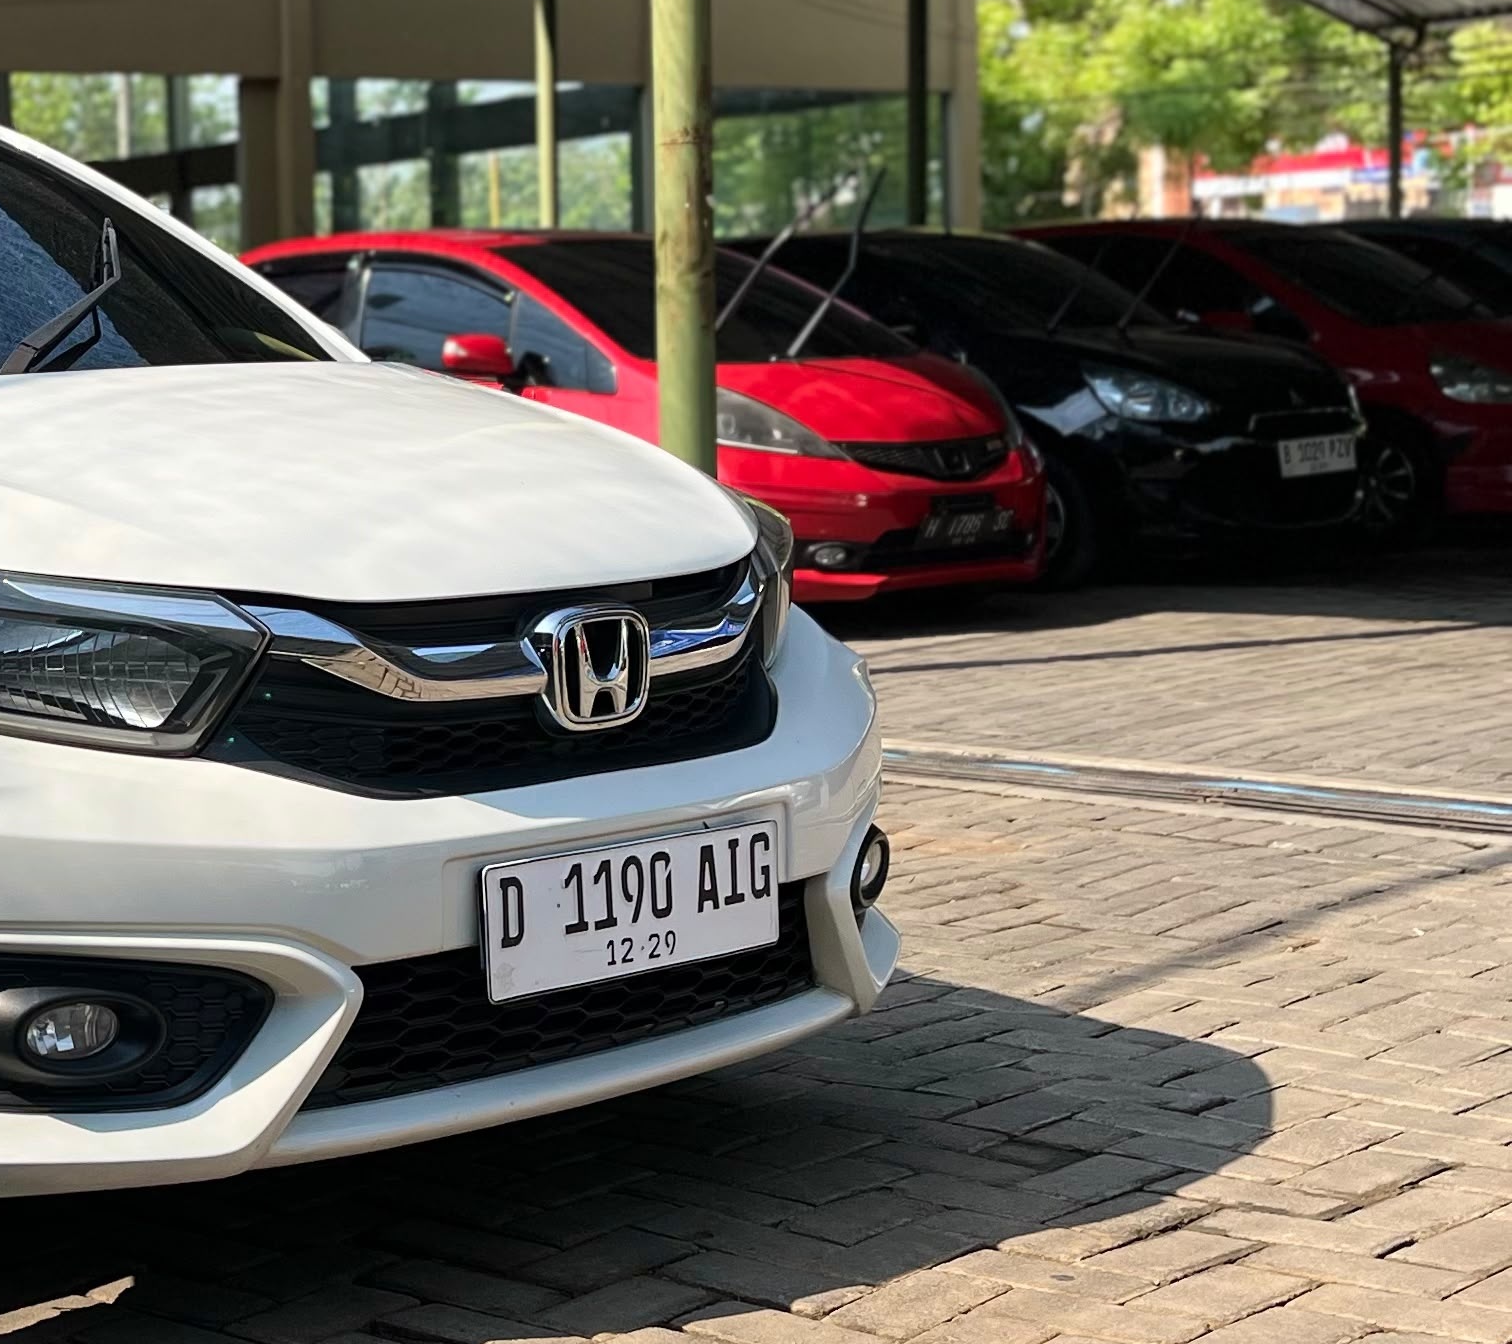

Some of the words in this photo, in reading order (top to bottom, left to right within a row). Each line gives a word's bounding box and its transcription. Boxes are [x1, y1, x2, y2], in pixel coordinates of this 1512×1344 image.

[500, 876, 525, 949] D
[564, 851, 673, 935] 1190
[697, 832, 771, 913] AIG
